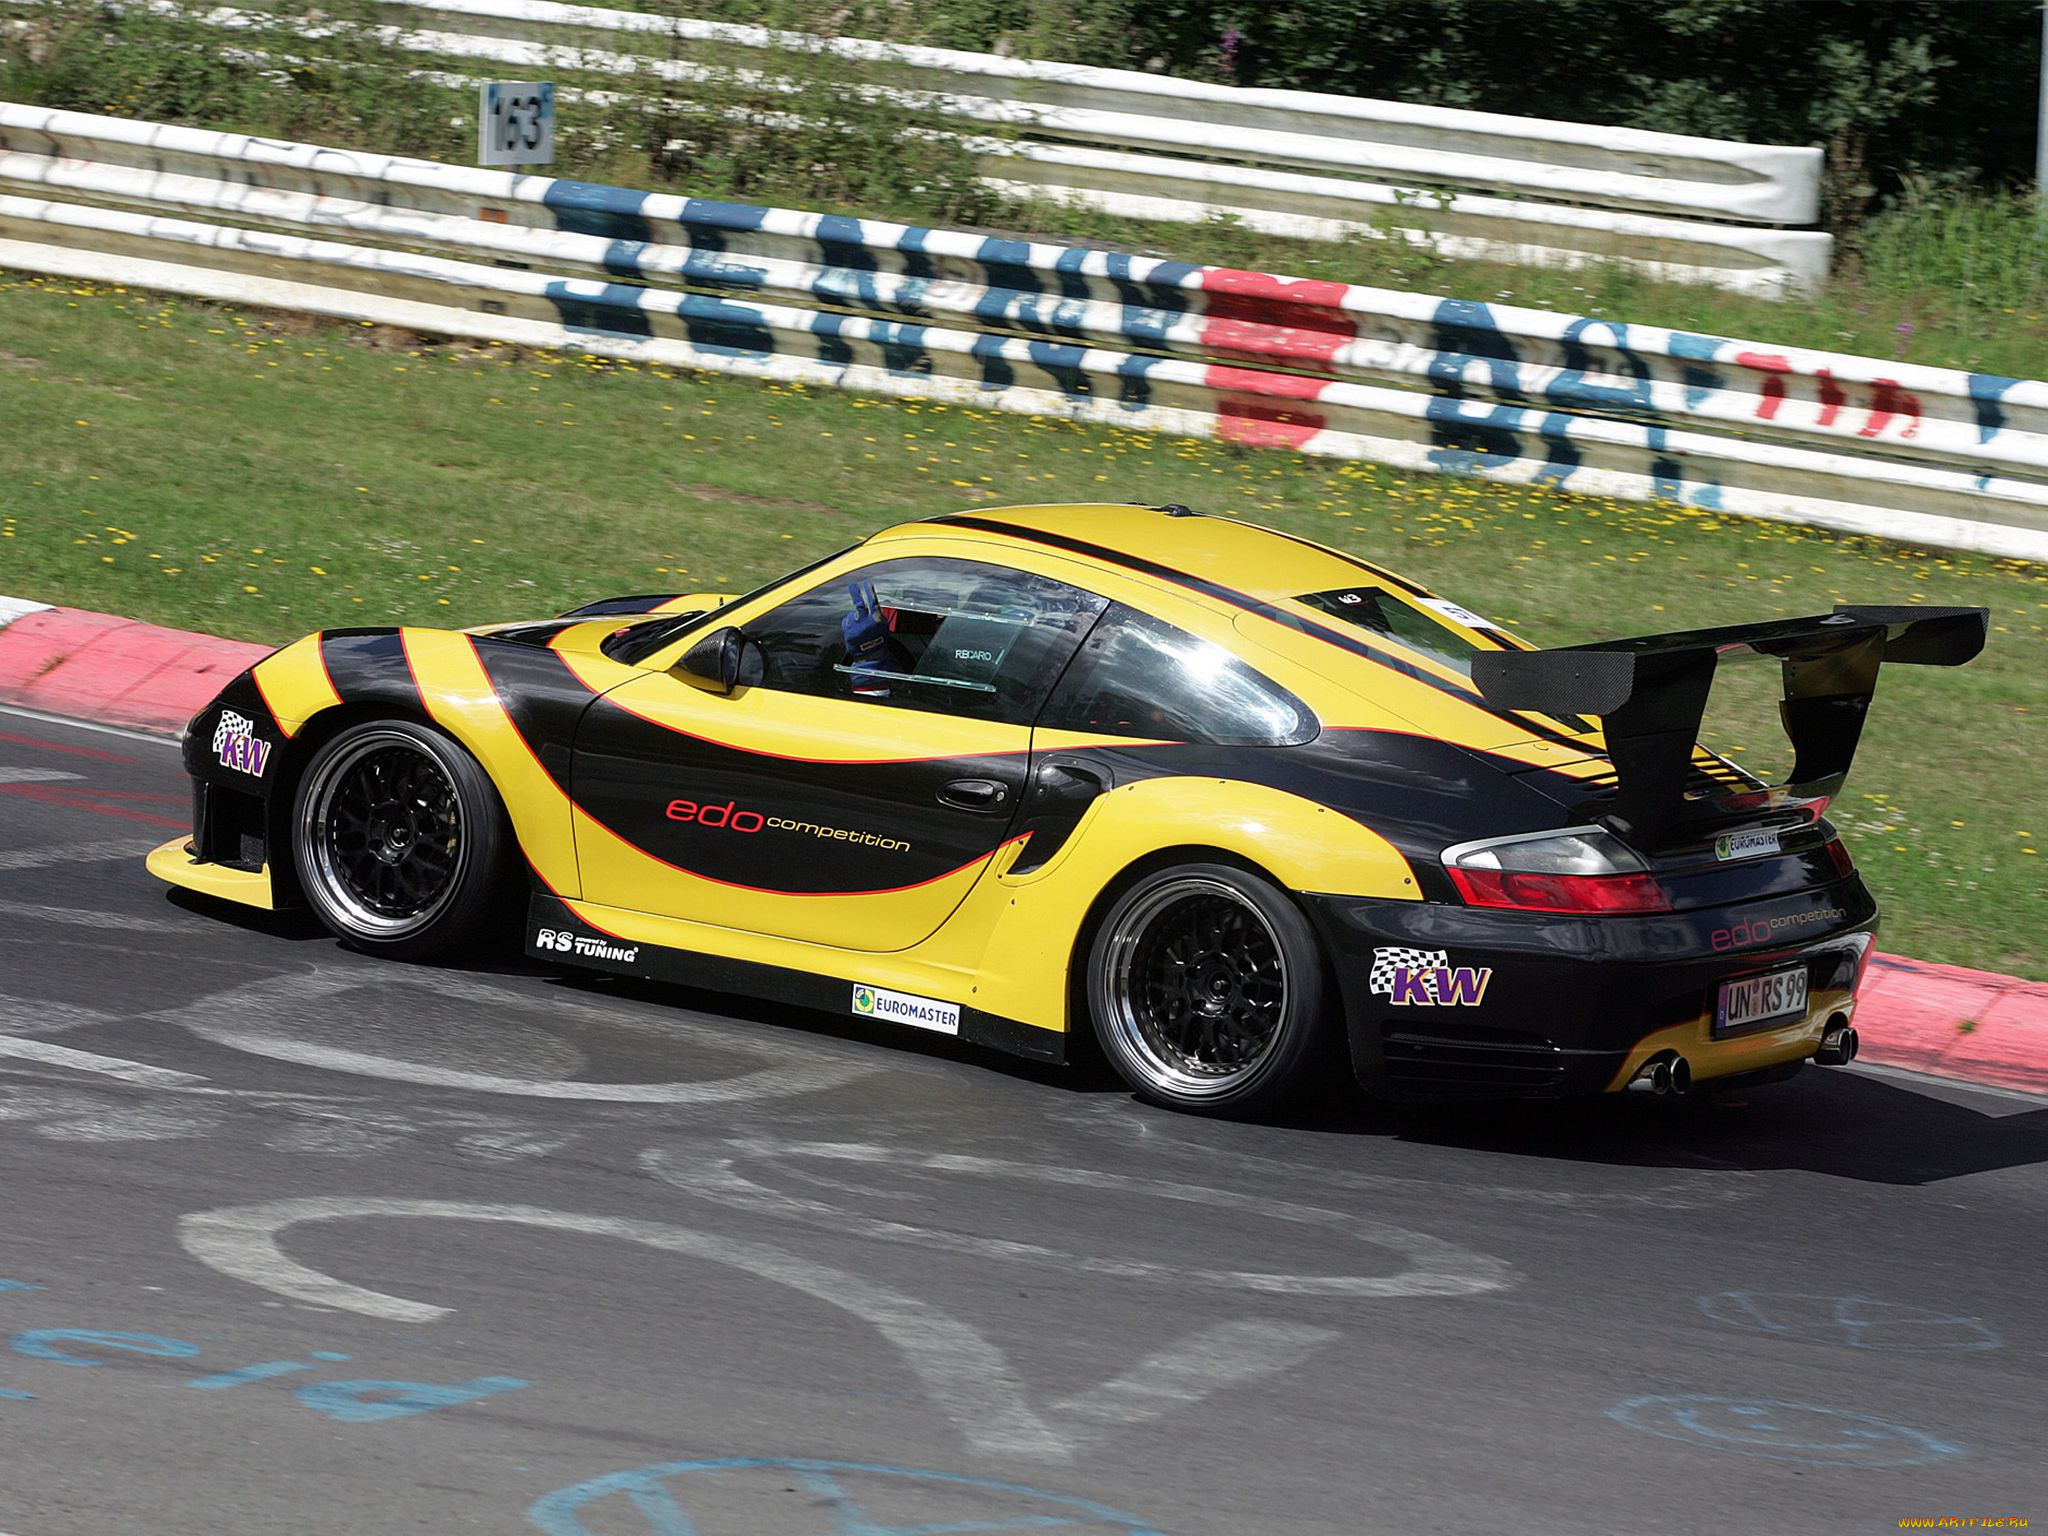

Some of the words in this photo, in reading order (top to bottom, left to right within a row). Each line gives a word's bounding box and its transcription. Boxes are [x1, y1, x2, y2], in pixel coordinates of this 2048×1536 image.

[955, 649, 992, 661] RECARO
[220, 730, 271, 778] KW
[665, 799, 764, 833] edo
[766, 816, 911, 853] competition
[1731, 834, 1776, 850] EUROMASTER
[536, 928, 574, 952] RS
[1711, 916, 1772, 951] edo
[1771, 908, 1846, 928] competition
[575, 942, 635, 962] TUNING
[1390, 967, 1493, 1006] KW
[1728, 984, 1751, 1021] UN
[1761, 976, 1783, 1014] RS
[1786, 971, 1807, 1009] 99
[876, 997, 957, 1026] EUROMASTER
